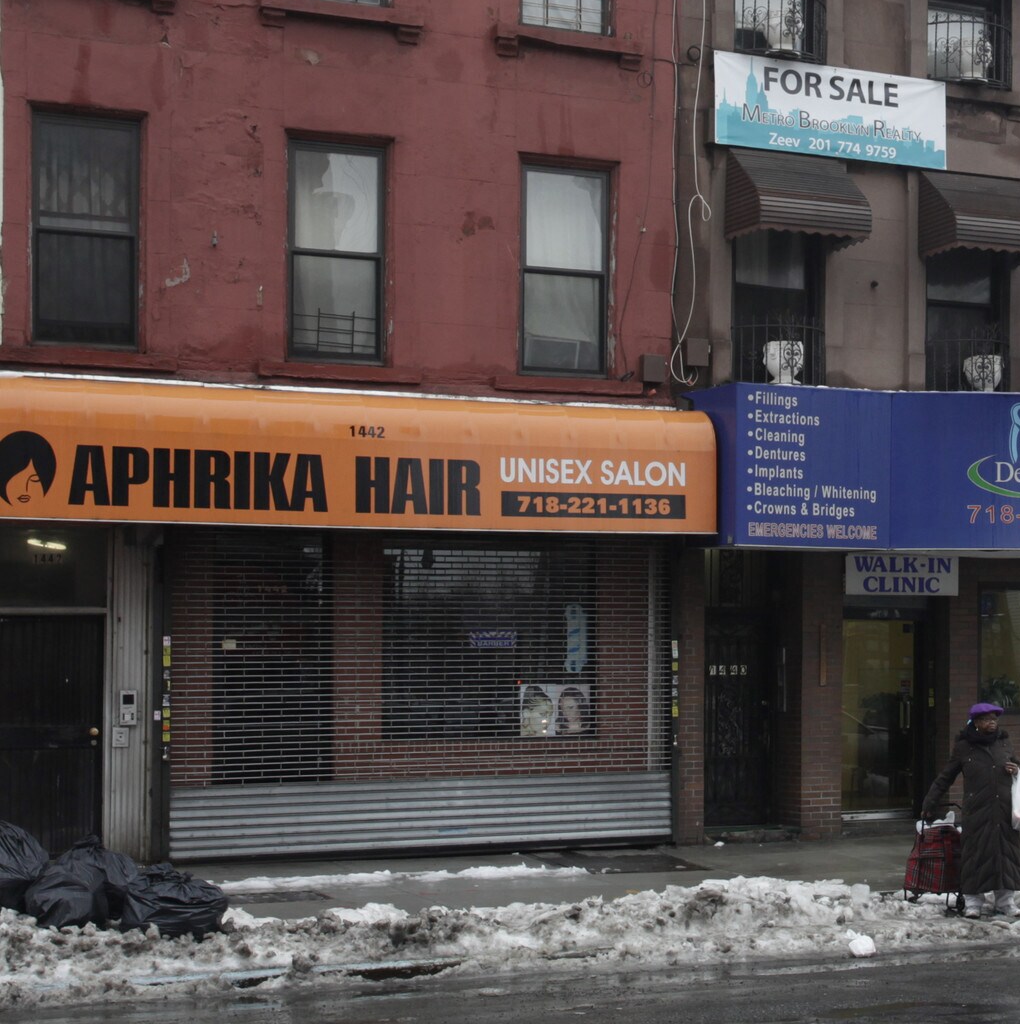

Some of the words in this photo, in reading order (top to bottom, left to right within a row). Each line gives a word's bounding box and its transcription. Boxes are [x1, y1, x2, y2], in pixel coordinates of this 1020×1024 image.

[764, 66, 822, 98] FOR
[829, 76, 899, 108] SALE
[742, 103, 795, 126] METRO
[799, 111, 869, 136] BROOKLYN
[769, 132, 800, 148] Zeev
[809, 137, 831, 151] 201
[838, 141, 861, 154] 774
[866, 145, 897, 159] 9759
[755, 391, 798, 409] Fillings
[755, 409, 820, 426] Extractions
[349, 425, 385, 439] 1442
[755, 428, 805, 446] Cleaning
[755, 446, 806, 461] Dentures
[68, 444, 328, 512] APHRIKA
[355, 455, 481, 516] HAIR
[500, 457, 592, 484] UNISEX
[601, 460, 686, 487] SALON
[755, 464, 803, 480] Implants
[754, 483, 810, 501] Bleaching
[821, 485, 877, 503] Whitening
[517, 496, 671, 515] 718-221-1136
[754, 501, 796, 515] Crowns
[801, 503, 808, 515] &
[812, 503, 855, 519] Bridges
[748, 522, 824, 539] EMERGENCIES
[827, 523, 878, 540] WELCOME
[853, 556, 952, 573] WALK-IN
[863, 576, 940, 593] CLINIC
